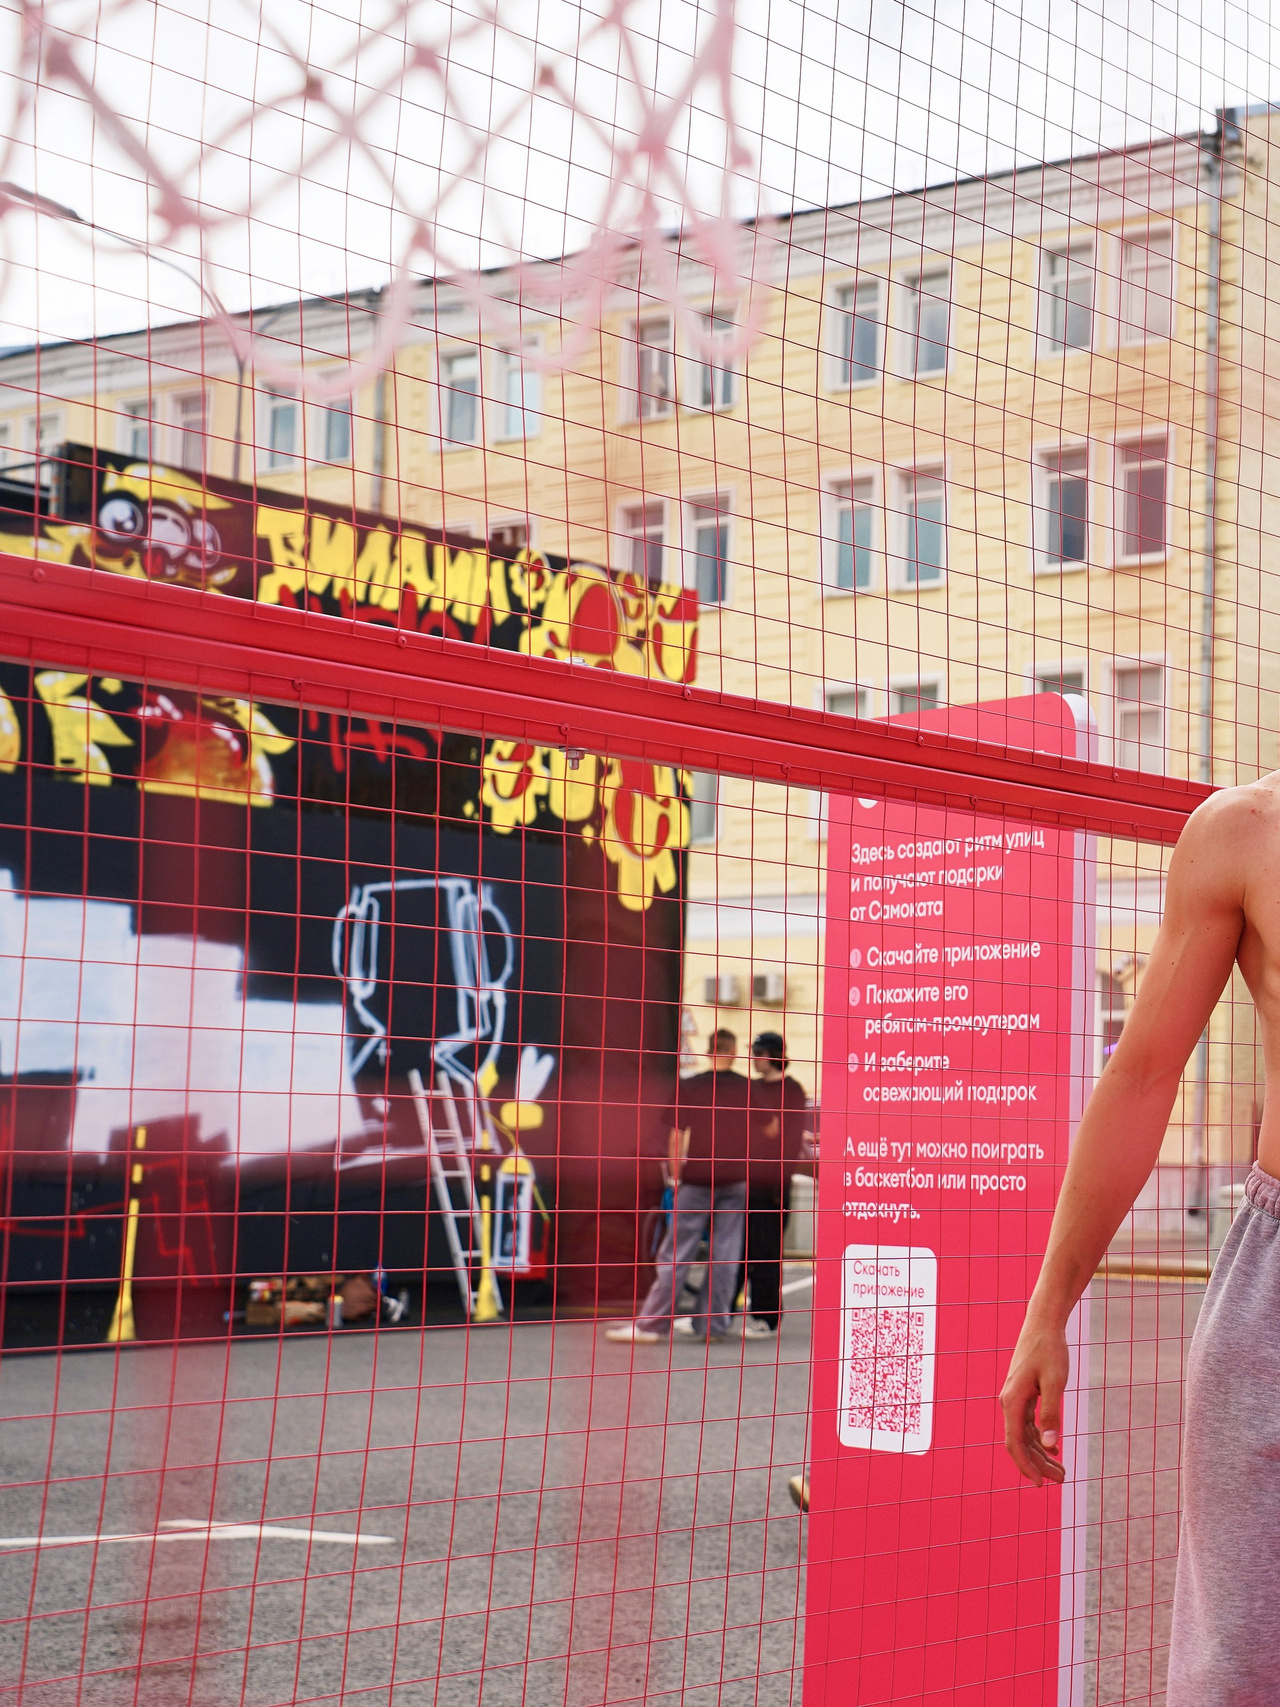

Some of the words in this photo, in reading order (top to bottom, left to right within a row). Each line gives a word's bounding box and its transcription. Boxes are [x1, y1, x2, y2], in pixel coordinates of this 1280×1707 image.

[851, 843, 895, 865] Здесь
[897, 838, 962, 860] создают
[965, 834, 1002, 858] ритм
[1005, 830, 1045, 855] улиц
[851, 877, 860, 893] и
[863, 871, 936, 895] получают
[938, 865, 1005, 887] подарки
[850, 906, 866, 921] от
[868, 900, 943, 920] Самоката
[867, 943, 938, 967] Скачайте
[942, 942, 1041, 967] приложение
[866, 984, 940, 1004] Покажите
[944, 985, 969, 1002] его
[865, 1013, 1040, 1039] ребятам-промоутерам
[864, 1051, 876, 1072] И
[880, 1050, 950, 1076] заберите
[863, 1080, 964, 1104] освежающий
[968, 1085, 1037, 1106] подарок
[843, 1136, 856, 1157] А
[858, 1137, 888, 1160] ещё
[891, 1141, 913, 1162] тут
[916, 1142, 968, 1159] можно
[972, 1143, 1044, 1164] поиграть
[843, 1171, 852, 1187] в
[855, 1166, 934, 1189] баскетбол
[938, 1174, 966, 1189] или
[970, 1175, 1027, 1195] просто
[842, 1201, 921, 1224] отдохнуть.
[853, 1260, 900, 1277] Скачать
[853, 1282, 925, 1298] приложение
